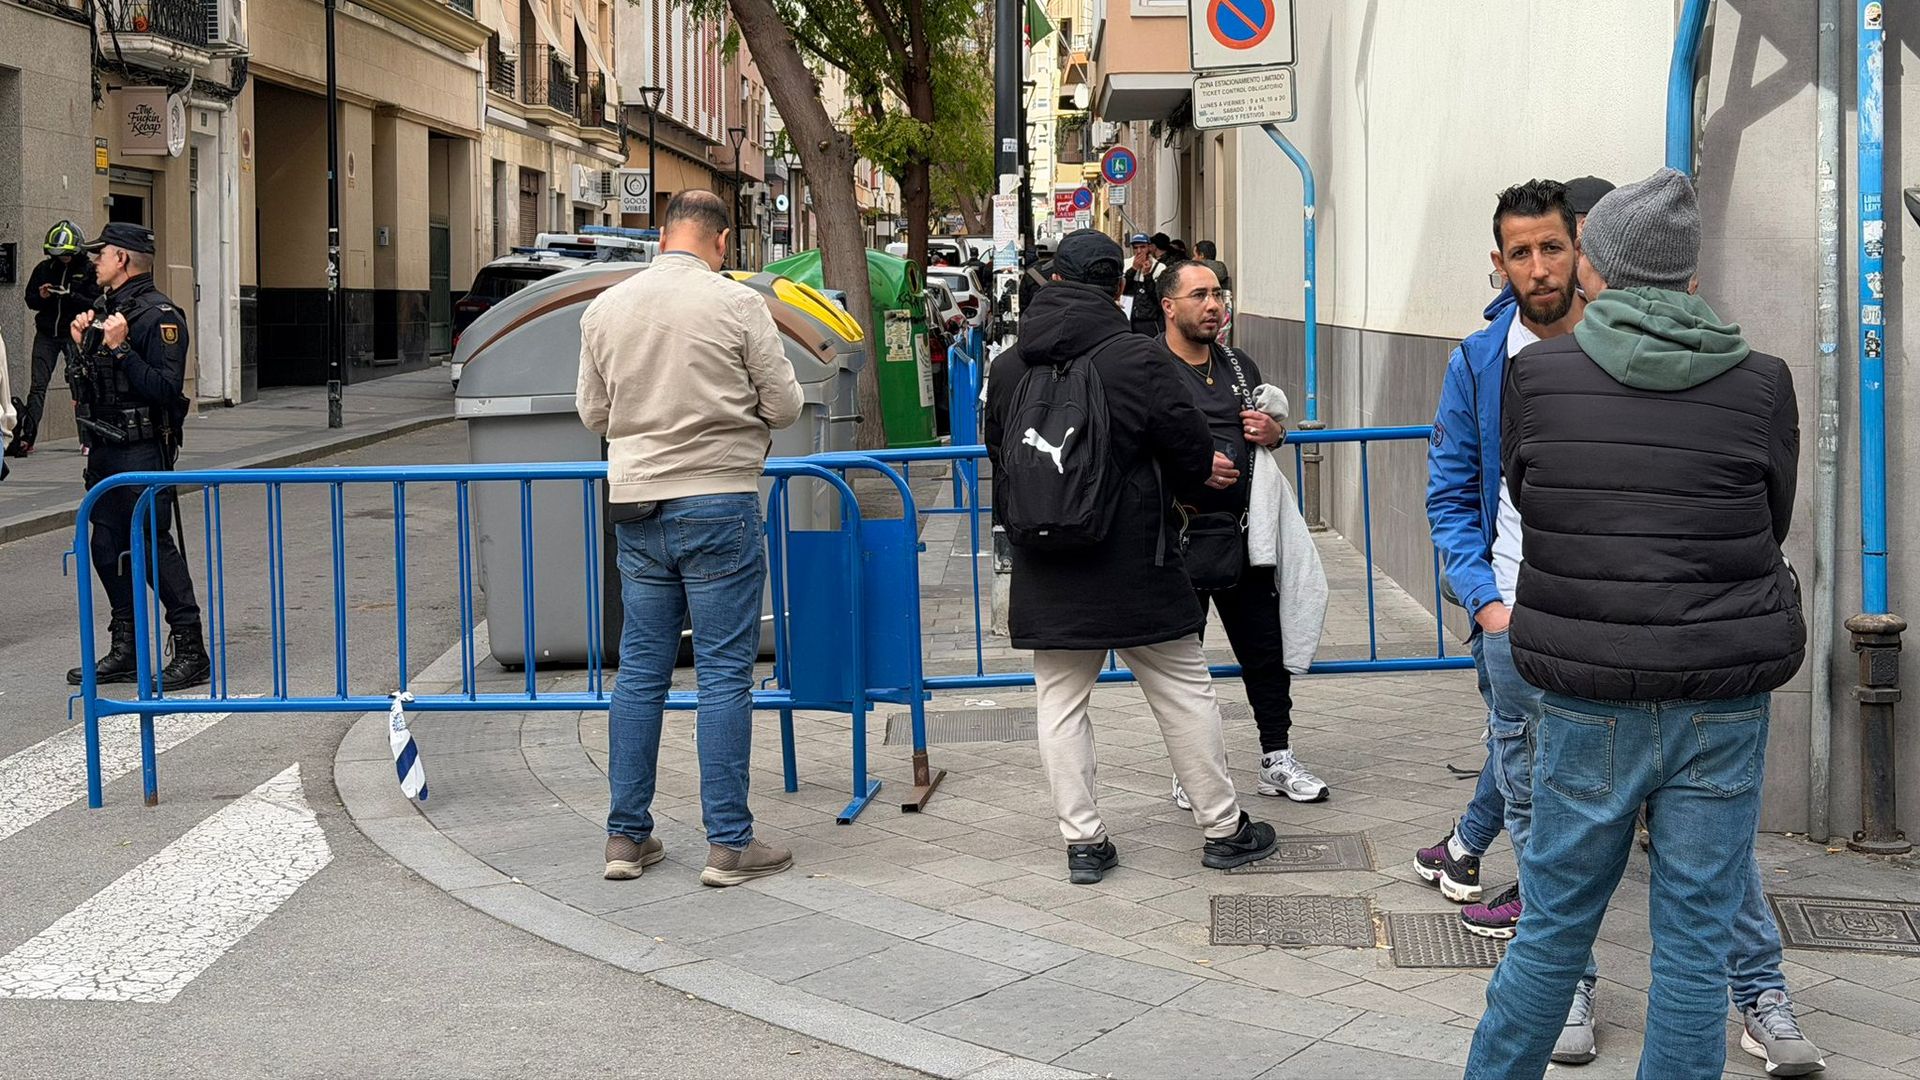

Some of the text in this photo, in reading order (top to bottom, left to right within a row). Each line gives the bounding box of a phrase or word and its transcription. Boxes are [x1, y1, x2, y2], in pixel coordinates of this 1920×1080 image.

[1199, 81, 1214, 89] ZONA
[1262, 73, 1284, 82] LIMITADO
[1221, 86, 1247, 95] CONTROL
[1248, 83, 1283, 92] OBLIGATORIO
[136, 104, 153, 114] The
[1200, 101, 1218, 109] LUNES
[1223, 98, 1246, 107] VIERNES
[1206, 114, 1234, 122] DOMINGOS
[1240, 112, 1265, 120] FESTIVOS
[131, 122, 162, 138] Kebap
[1230, 358, 1247, 388] HUGO
